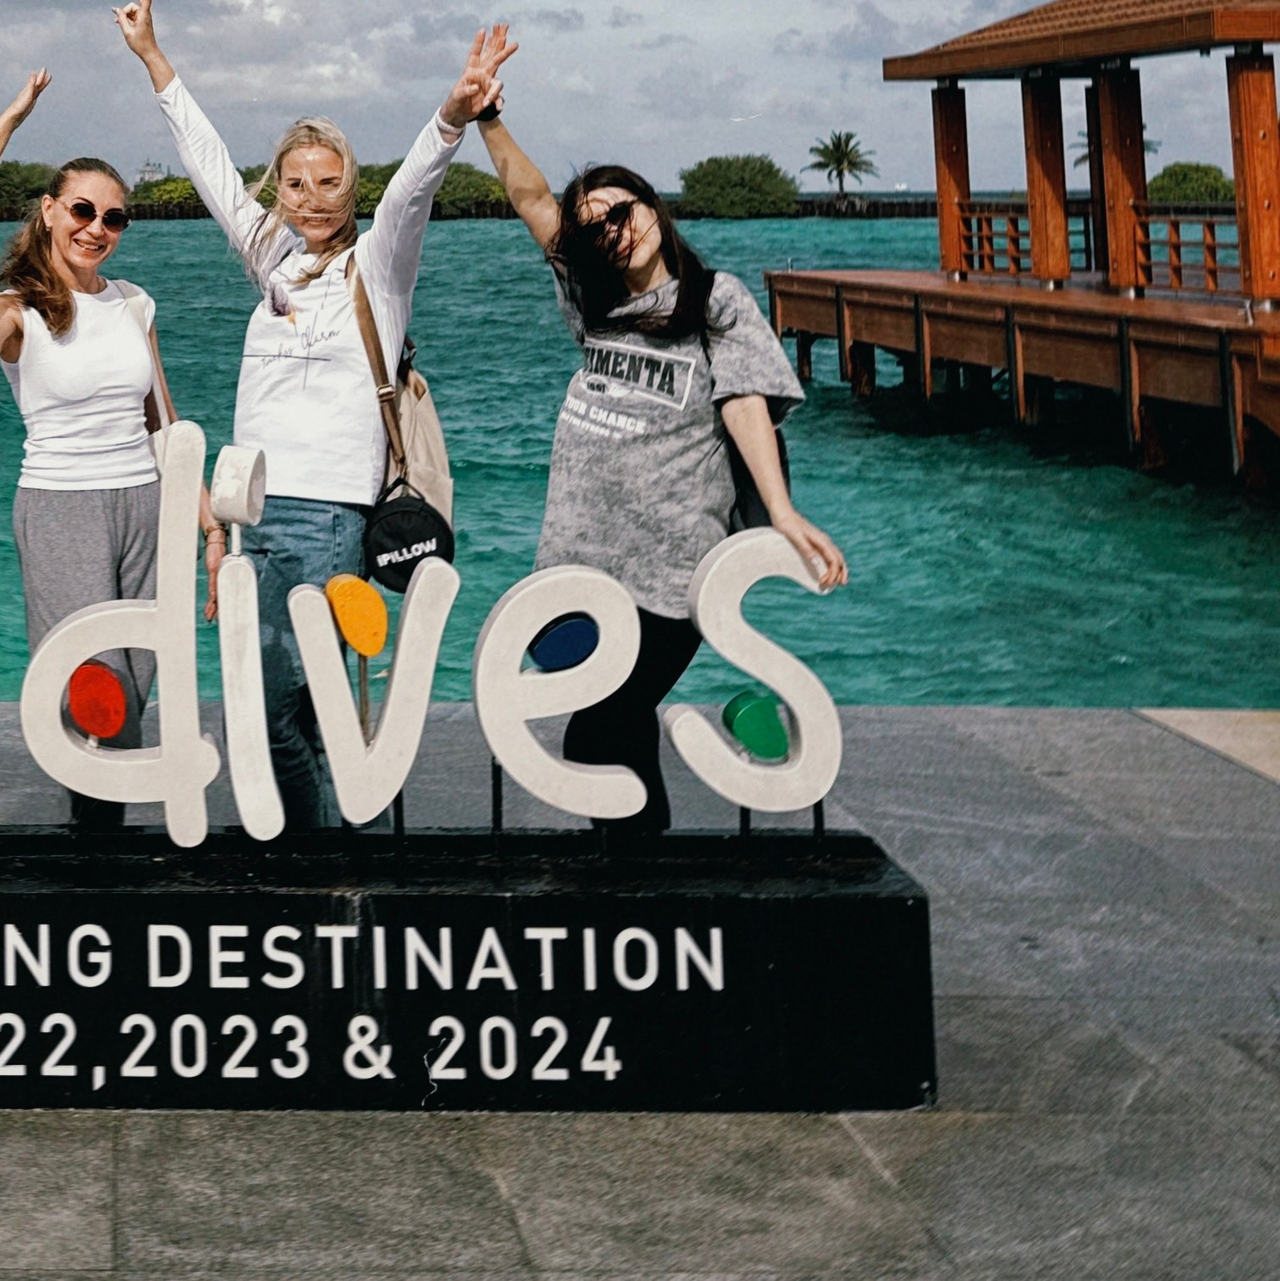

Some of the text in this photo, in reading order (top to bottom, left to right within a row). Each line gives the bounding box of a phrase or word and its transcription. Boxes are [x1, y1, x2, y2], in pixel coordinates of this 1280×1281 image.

[589, 405, 647, 435] CHANCE
[147, 924, 724, 991] DESTINATION
[343, 1014, 396, 1080] &
[428, 1015, 622, 1081] 2024
